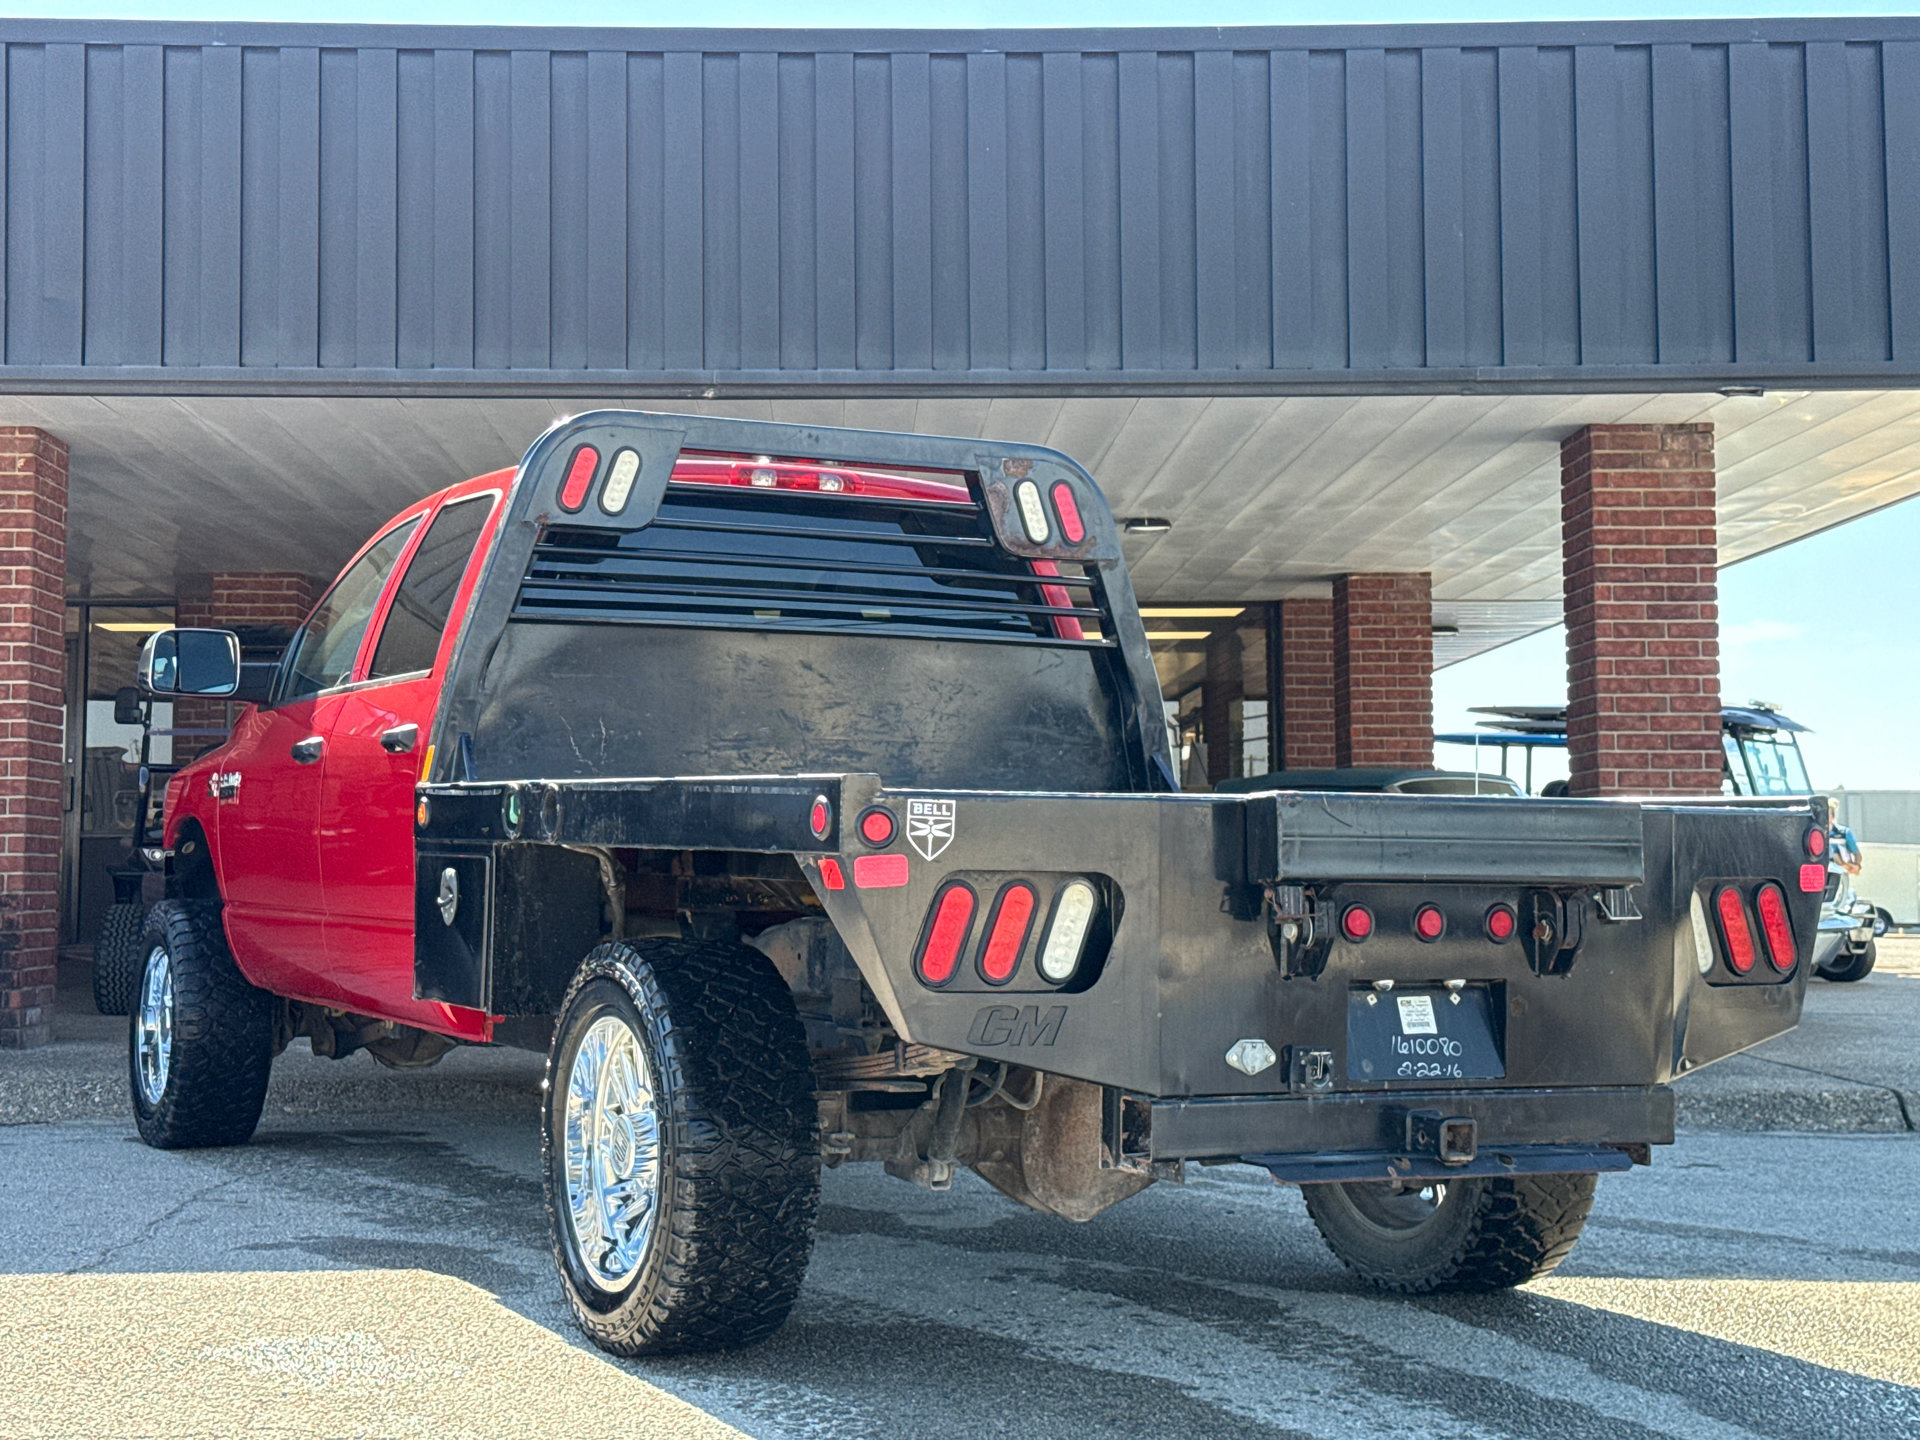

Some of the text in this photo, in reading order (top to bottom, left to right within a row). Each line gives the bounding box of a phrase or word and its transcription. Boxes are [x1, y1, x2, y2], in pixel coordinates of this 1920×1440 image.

[912, 802, 951, 816] BELL
[966, 1005, 1068, 1047] CM
[1391, 1035, 1463, 1057] 1610080
